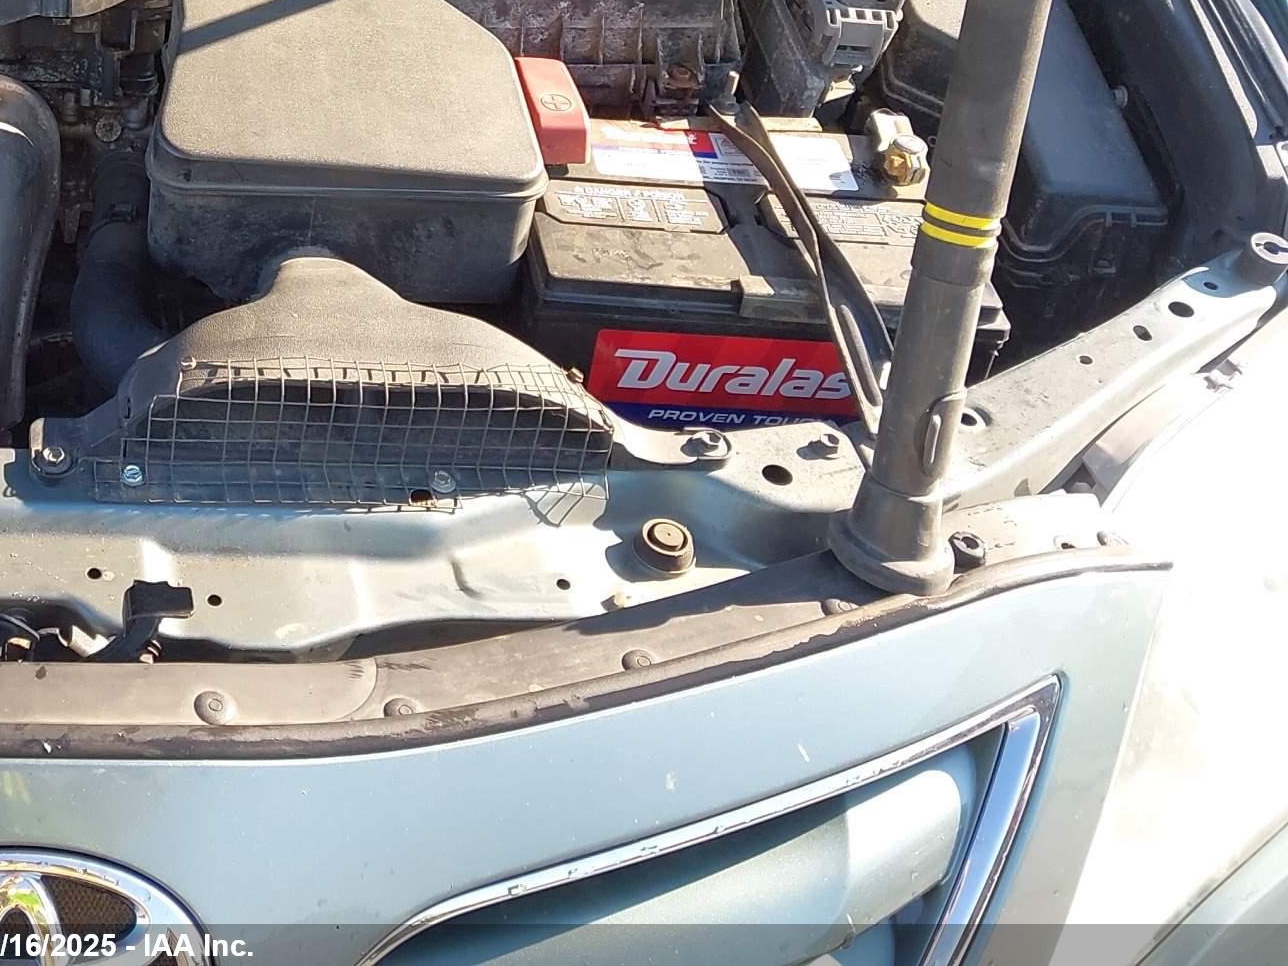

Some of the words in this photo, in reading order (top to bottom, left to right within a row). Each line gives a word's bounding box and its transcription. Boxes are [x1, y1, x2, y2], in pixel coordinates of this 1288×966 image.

[614, 348, 852, 400] Duralas
[648, 409, 744, 424] PROVEN
[752, 415, 830, 427] TOU
